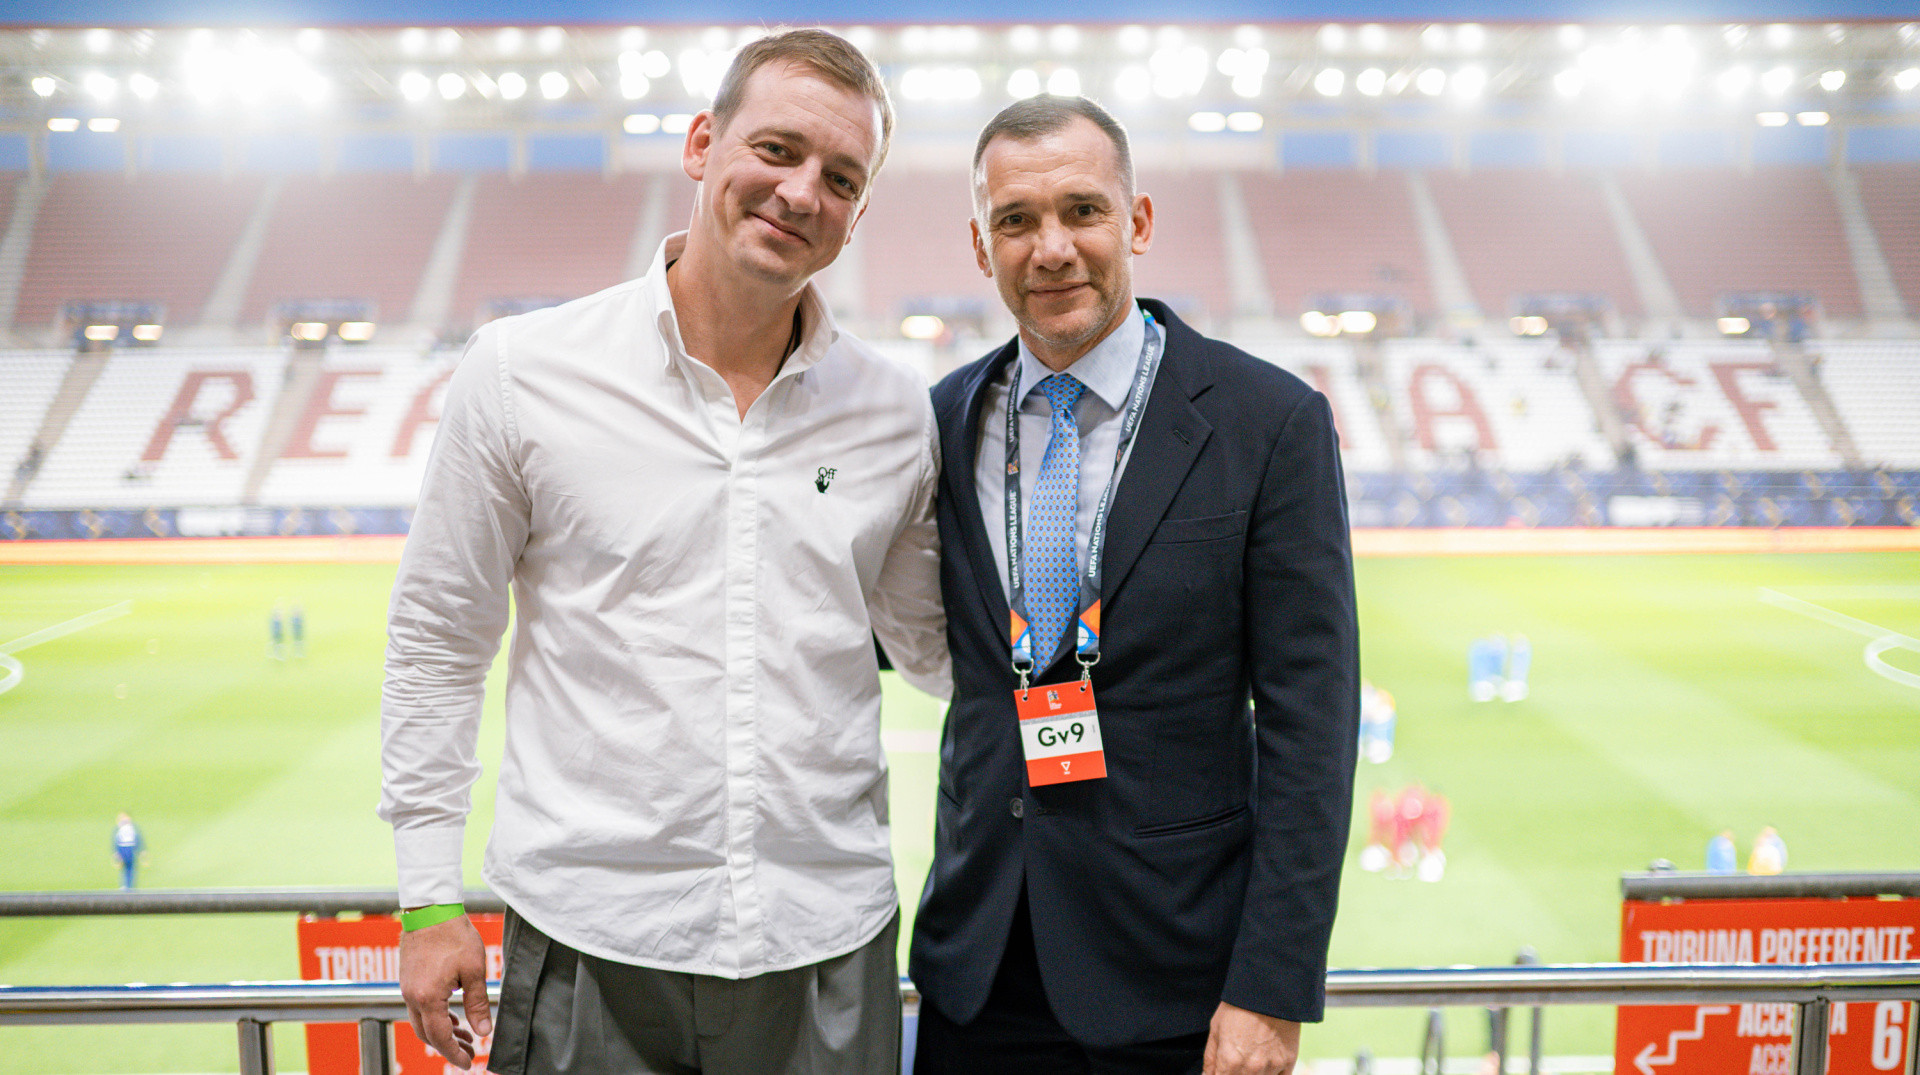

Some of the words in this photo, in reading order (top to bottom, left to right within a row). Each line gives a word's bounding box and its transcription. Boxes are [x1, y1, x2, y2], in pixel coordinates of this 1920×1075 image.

[1126, 411, 1137, 432] UEFA
[1132, 375, 1148, 412] NATIONS
[1142, 344, 1155, 376] LEAGUE
[1614, 363, 1779, 450] CF
[817, 466, 838, 479] Off
[1009, 489, 1017, 526] LEAGUE
[1009, 526, 1018, 565] NATIONS
[1091, 512, 1104, 554] NATIONS
[1012, 565, 1020, 589] UEFA
[1088, 554, 1098, 578] UEFA
[1037, 722, 1084, 747] Gv9
[1640, 928, 1753, 965] TRIBUNA
[1760, 926, 1915, 966] PREFERENTE
[1871, 1000, 1904, 1071] 6
